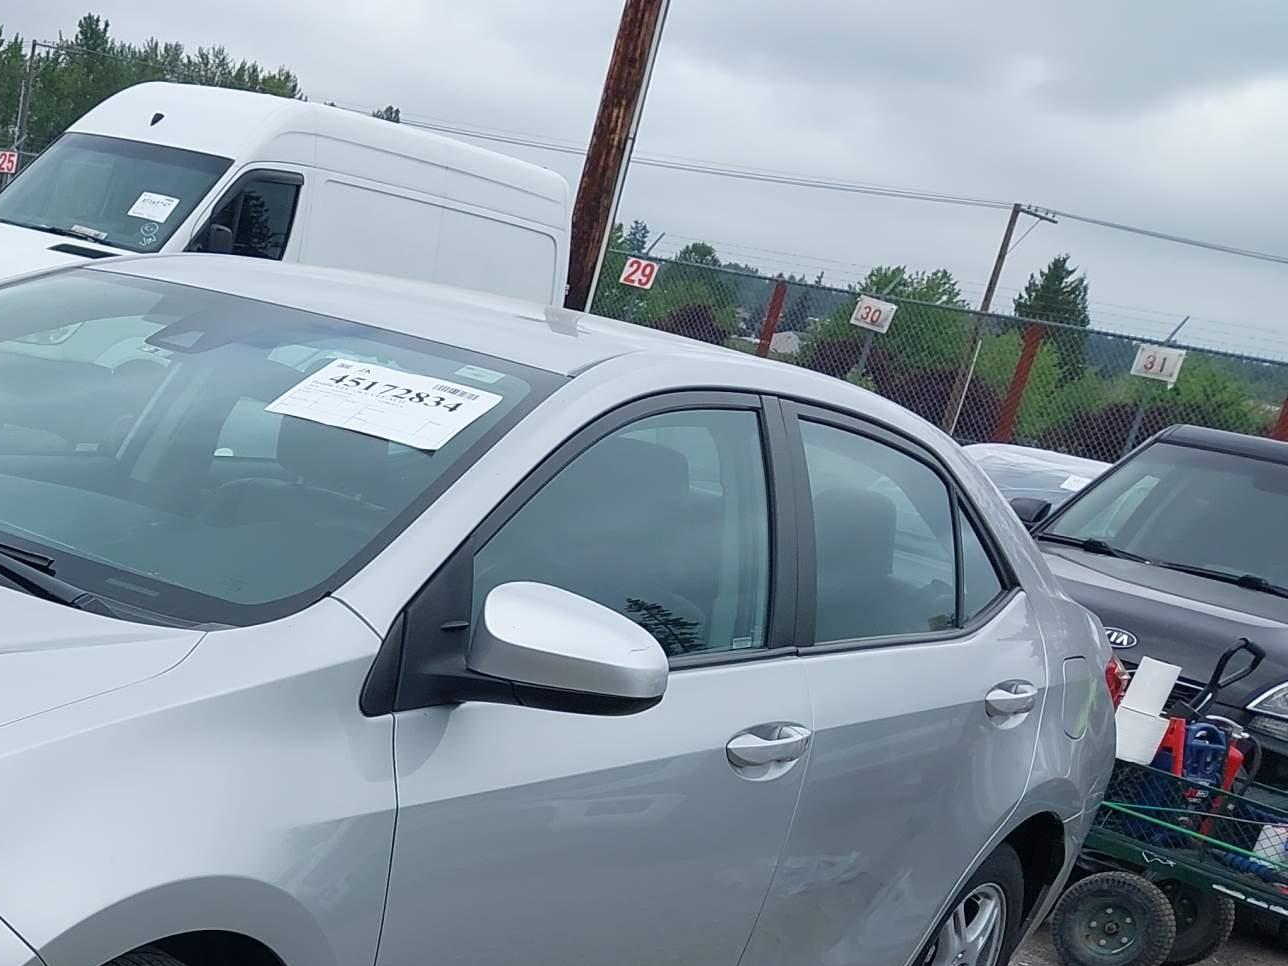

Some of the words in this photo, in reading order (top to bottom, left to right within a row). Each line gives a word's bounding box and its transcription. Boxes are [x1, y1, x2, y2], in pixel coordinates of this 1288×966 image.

[623, 259, 655, 286] 29
[860, 305, 882, 324] 30
[1143, 354, 1168, 373] 31
[329, 374, 463, 413] 45172834
